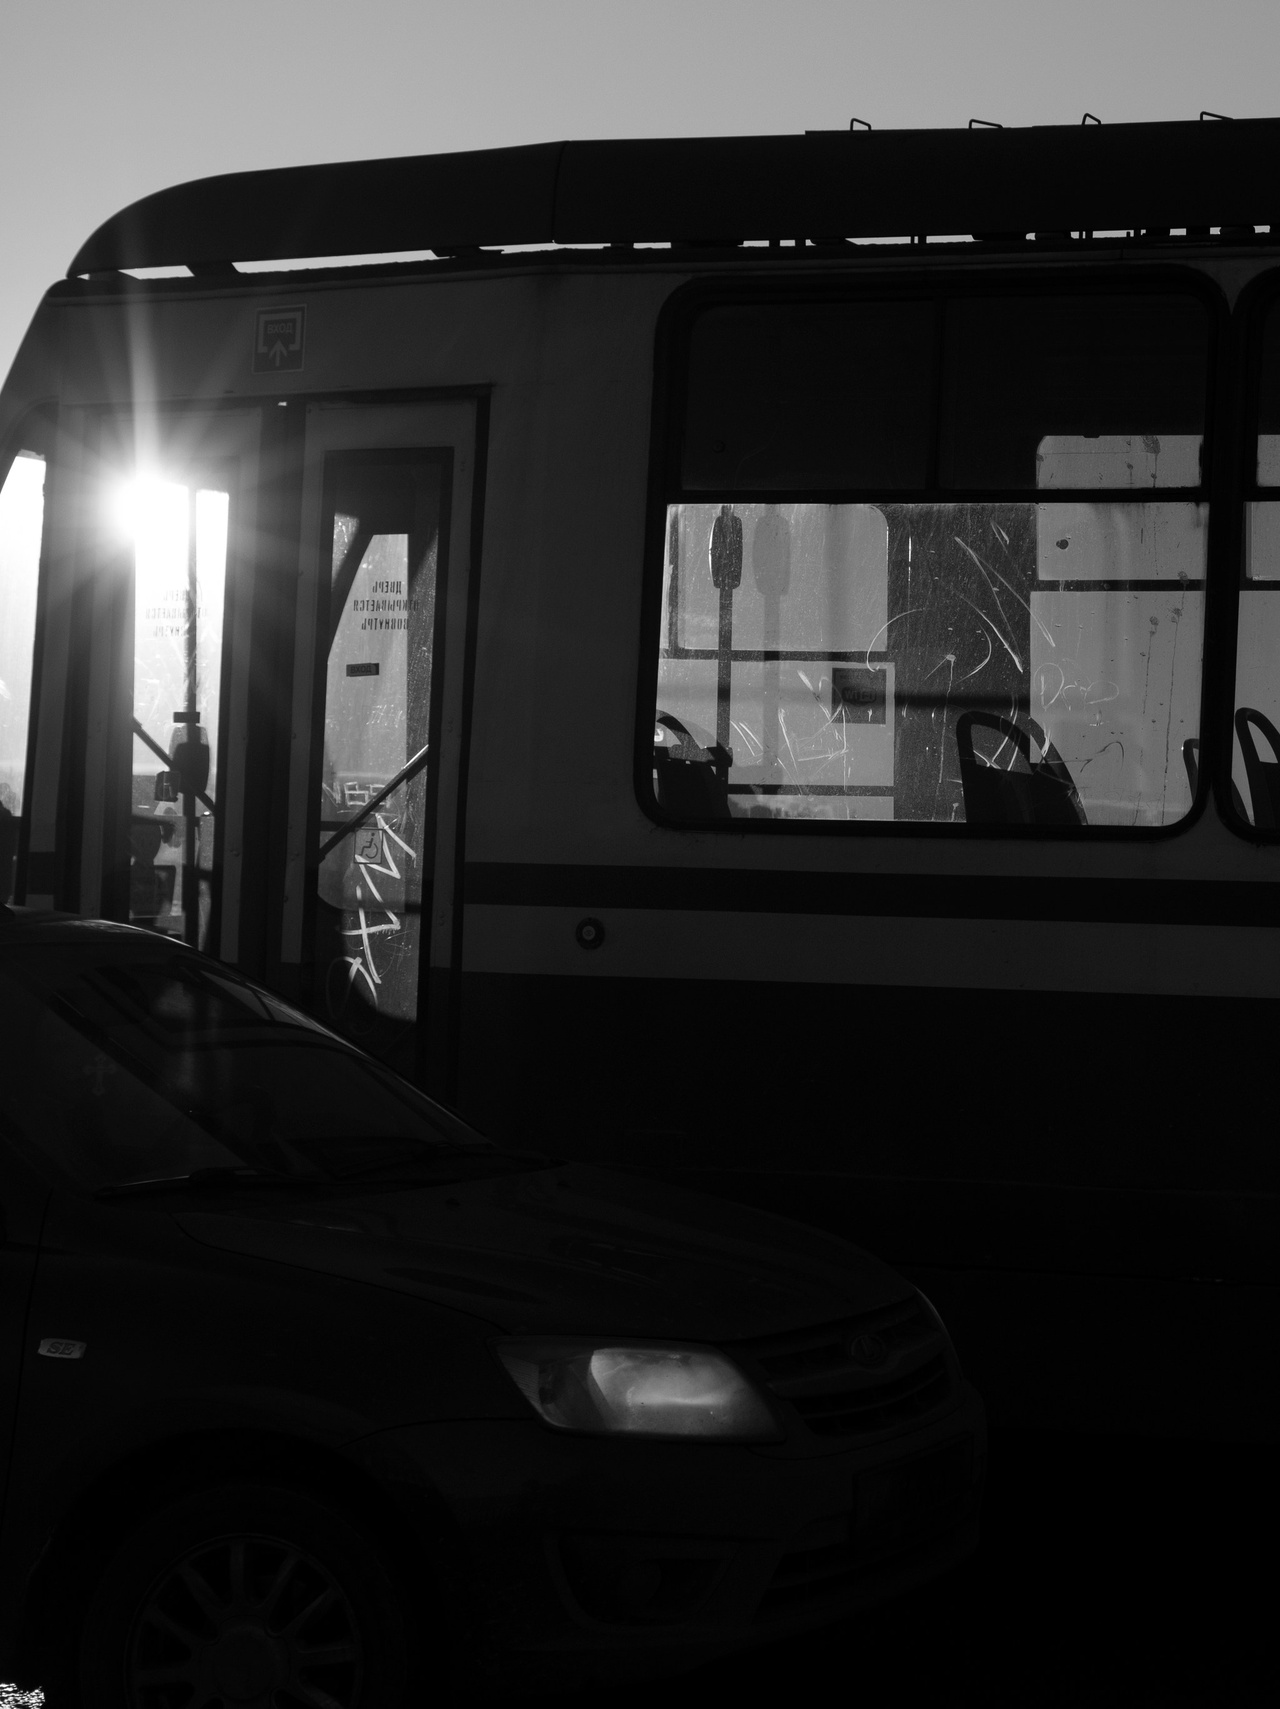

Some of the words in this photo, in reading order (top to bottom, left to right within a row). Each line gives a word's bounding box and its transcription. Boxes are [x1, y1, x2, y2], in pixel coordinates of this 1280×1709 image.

[267, 322, 293, 334] ВХОД
[350, 665, 372, 674] ВХОД
[47, 1341, 75, 1356] SE
